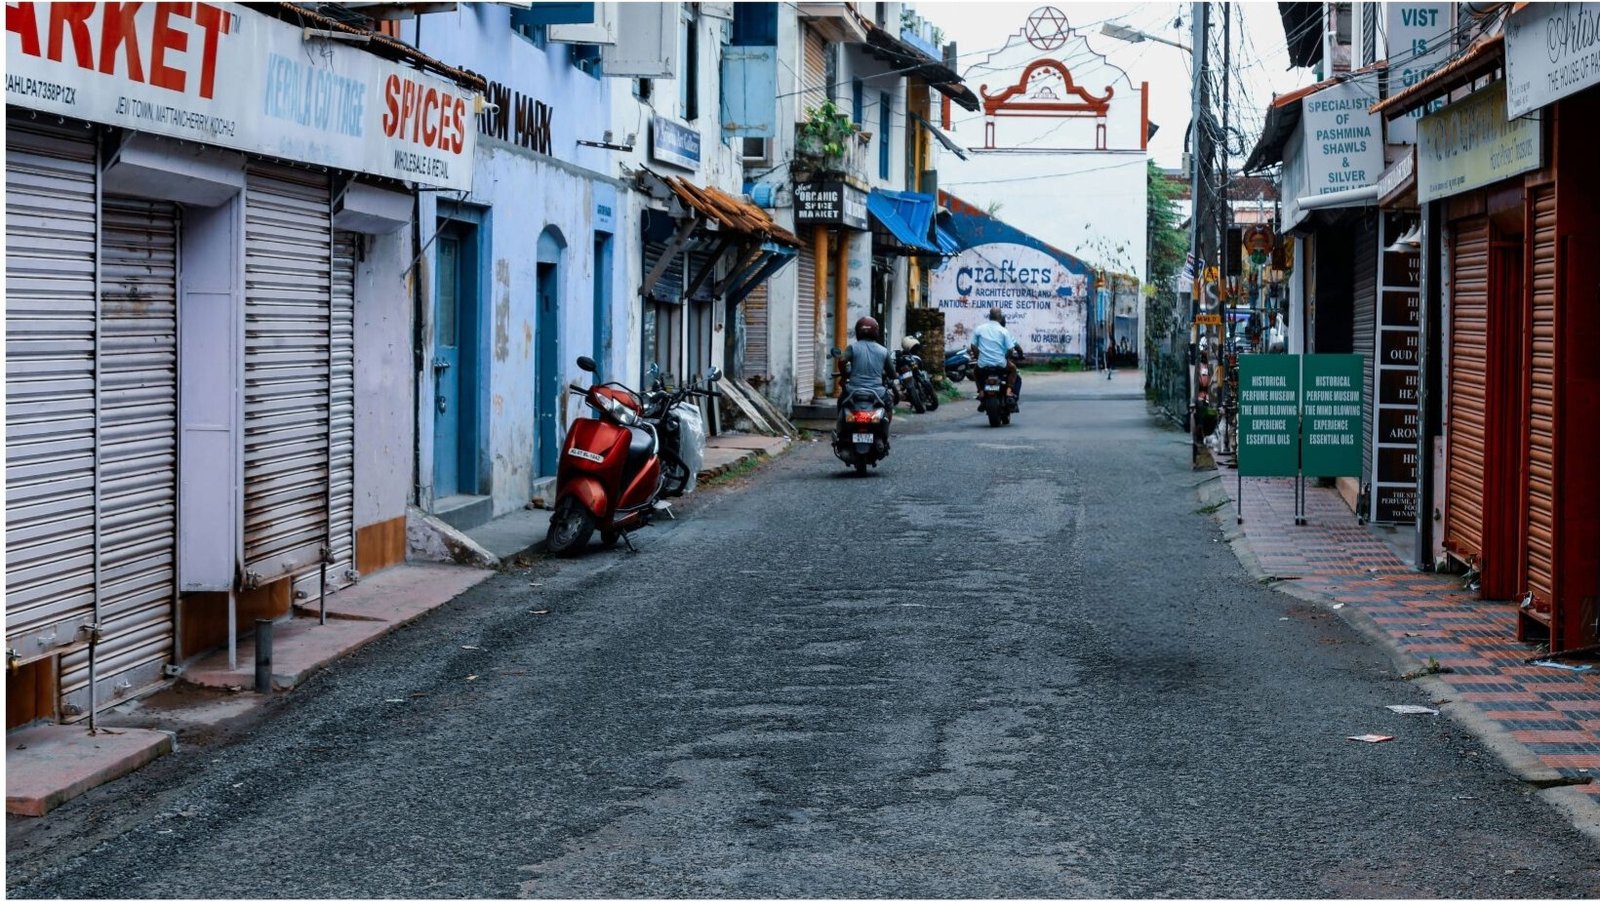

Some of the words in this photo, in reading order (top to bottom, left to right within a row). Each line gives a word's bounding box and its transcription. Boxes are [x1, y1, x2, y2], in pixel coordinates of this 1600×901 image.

[1401, 8, 1438, 27] VIST
[6, 2, 230, 99] ARKET
[1412, 38, 1427, 56] IS
[1548, 70, 1559, 92] THE
[1559, 60, 1579, 88] HOUSE
[1580, 55, 1589, 79] OF
[1590, 50, 1600, 76] PA
[6, 72, 76, 105] AHLPA7358P1ZX
[115, 96, 130, 116] JEW
[1308, 98, 1376, 113] SPECIALISTS
[382, 73, 465, 155] SPICES
[1335, 114, 1350, 125] OF
[514, 91, 553, 157] MARK
[1316, 126, 1371, 141] PASHMINA
[1323, 141, 1367, 155] SHAWLS
[394, 149, 426, 175] WHOLESALE
[427, 157, 431, 175] &
[432, 158, 449, 180] RETAIL
[1342, 157, 1350, 167] &
[1328, 170, 1366, 183] SILVER
[799, 191, 838, 202] ORGANIC
[804, 202, 833, 210] SPICE
[798, 210, 839, 218] MARKET
[956, 259, 1052, 296] Crafters
[975, 287, 1035, 298] ARCHITECTURAL
[1037, 289, 1051, 298] AND
[971, 300, 1013, 309] FURNITURE
[1016, 300, 1051, 309] SECTION
[1031, 334, 1042, 343] NO
[1390, 350, 1412, 360] OUD
[1252, 376, 1286, 387] HISTORICAL
[1315, 376, 1350, 387] HISTORICAL
[1242, 390, 1268, 401] PERFUME
[1269, 390, 1295, 401] MUSEUM
[1306, 390, 1333, 401] PERFUME
[1334, 390, 1360, 401] MUSEUM
[1241, 405, 1252, 416] THE
[1253, 405, 1268, 416] MIND
[1269, 405, 1297, 416] BLOWING
[1305, 405, 1316, 416] THE
[1316, 405, 1332, 416] MIND
[1333, 405, 1360, 416] BLOWING
[1252, 420, 1286, 430] EXPERIENCE
[1313, 420, 1348, 430] EXPERIENCE
[1246, 434, 1276, 445] ESSENTIAL
[1277, 434, 1290, 445] OILS
[1309, 434, 1340, 445] ESSENTIAL
[1341, 434, 1354, 445] OILS
